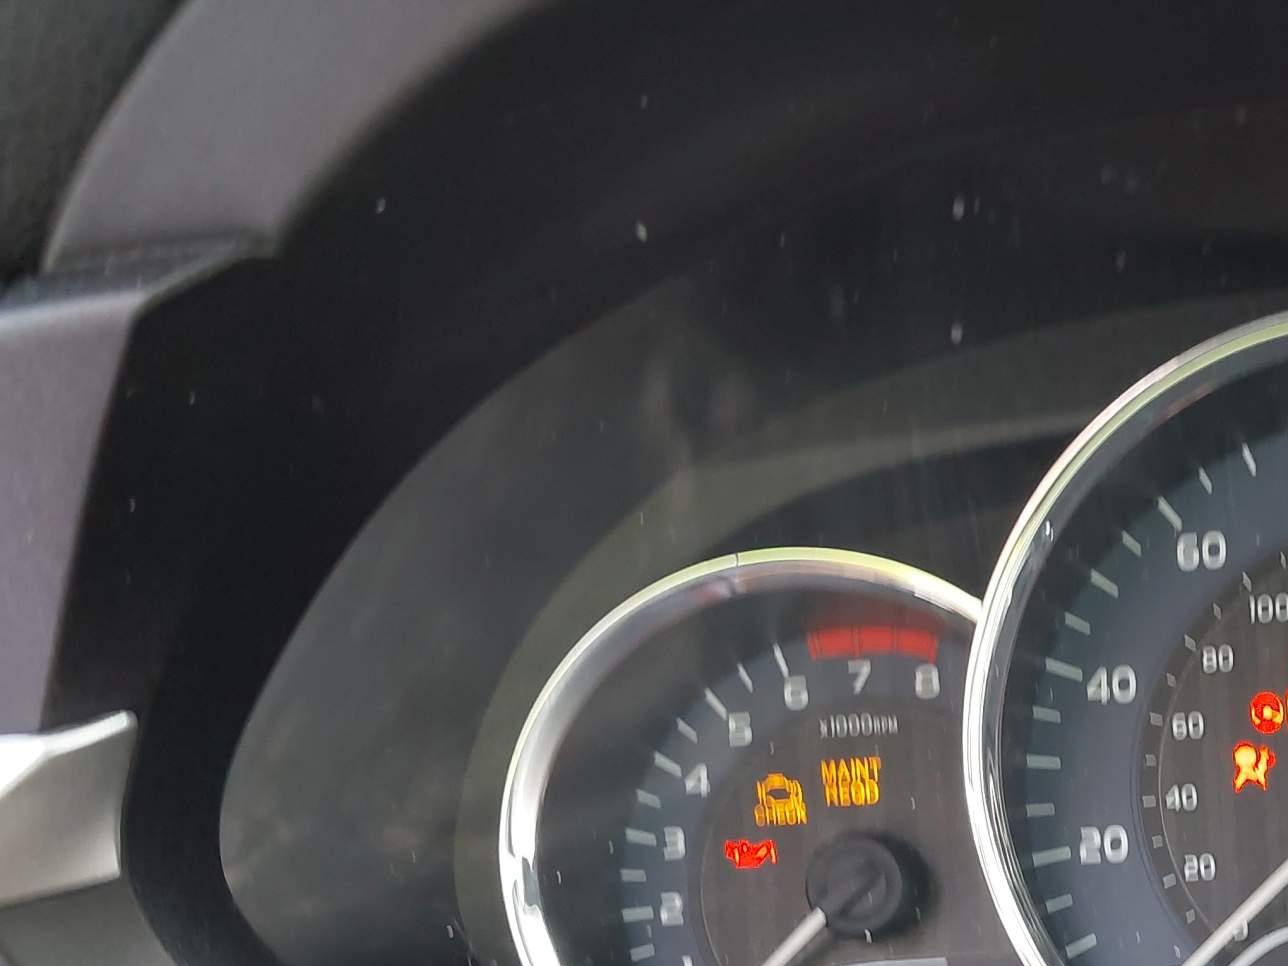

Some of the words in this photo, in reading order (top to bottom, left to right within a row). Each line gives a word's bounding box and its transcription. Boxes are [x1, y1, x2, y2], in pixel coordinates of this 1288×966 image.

[1177, 531, 1227, 572] 60
[848, 659, 871, 694] 7
[1201, 645, 1234, 674] 80
[784, 675, 808, 711] 6
[914, 663, 940, 699] 8
[1087, 665, 1138, 705] 40
[729, 712, 753, 747] 5
[1172, 711, 1205, 741] 60
[686, 762, 709, 797] 4
[821, 756, 881, 783] MAINT
[825, 778, 879, 807] REQD
[1165, 783, 1198, 812] 40
[754, 801, 807, 826] CHECK
[663, 827, 686, 861] 3
[1079, 825, 1129, 865] 20
[1184, 853, 1217, 883] 20
[660, 891, 684, 926] 2
